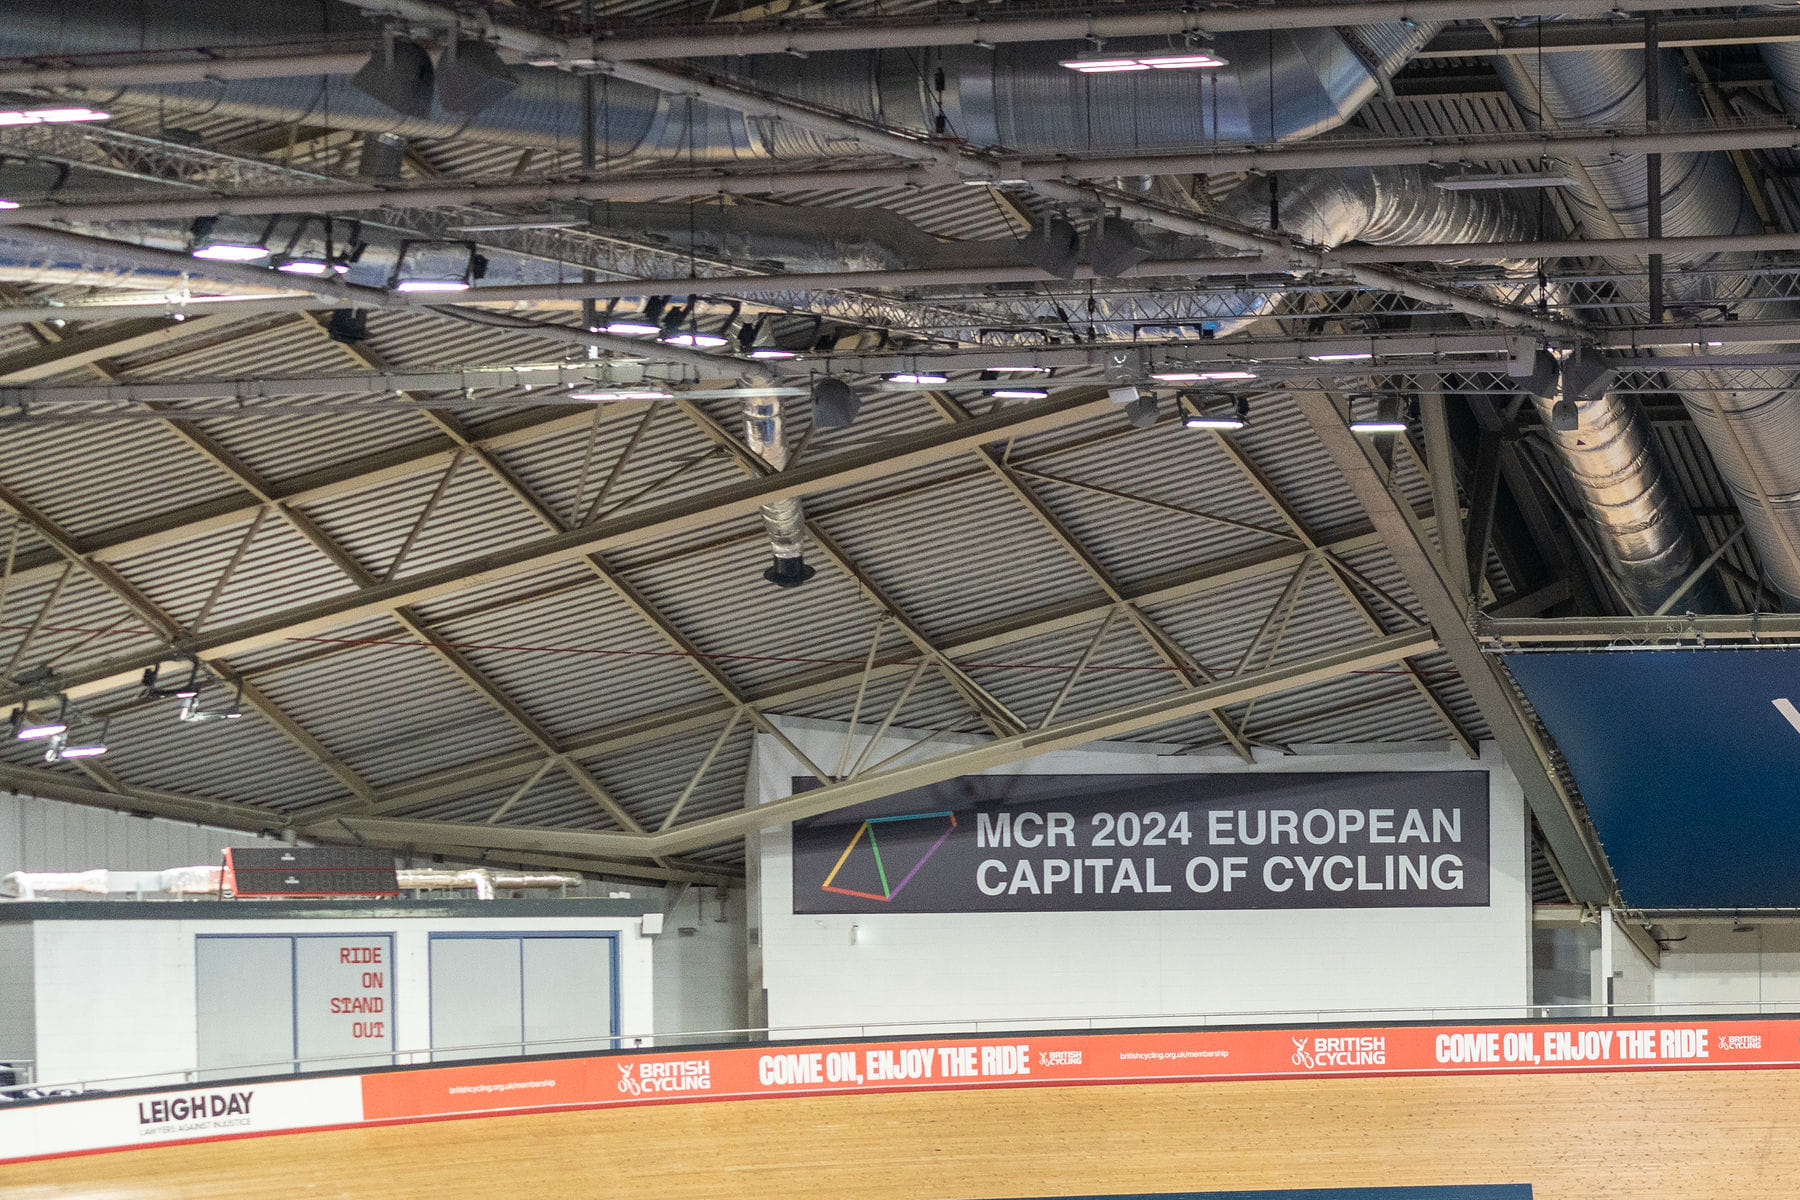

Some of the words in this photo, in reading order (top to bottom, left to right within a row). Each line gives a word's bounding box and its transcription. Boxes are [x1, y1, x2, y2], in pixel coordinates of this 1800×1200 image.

[976, 812, 1077, 848] MCR
[1091, 811, 1193, 848] 2024
[1208, 808, 1463, 847] EUROPEAN
[975, 856, 1172, 896] CAPITAL
[1182, 856, 1249, 894] OF
[1261, 853, 1465, 893] CYCLING
[340, 947, 382, 964] RIDE
[362, 972, 383, 989] ON
[330, 997, 384, 1014] STAND
[352, 1022, 384, 1038] OUT
[1315, 1036, 1385, 1052] BRITISH
[1435, 1032, 1500, 1063] COME
[1503, 1031, 1541, 1064] ON,
[1544, 1030, 1613, 1060] ENJOY
[1617, 1029, 1656, 1059] THE
[1660, 1029, 1709, 1058] RIDE
[1728, 1041, 1761, 1049] CYCLING
[759, 1052, 823, 1086] COME
[826, 1050, 864, 1085] ON,
[866, 1048, 935, 1080] ENJOY
[938, 1046, 977, 1077] THE
[981, 1045, 1030, 1075] RIDE
[1315, 1051, 1385, 1065] CYCLING
[640, 1060, 710, 1078] BRITISH
[641, 1076, 711, 1092] CYCLING
[139, 1096, 207, 1125] LEIGH
[211, 1091, 254, 1117] DAY
